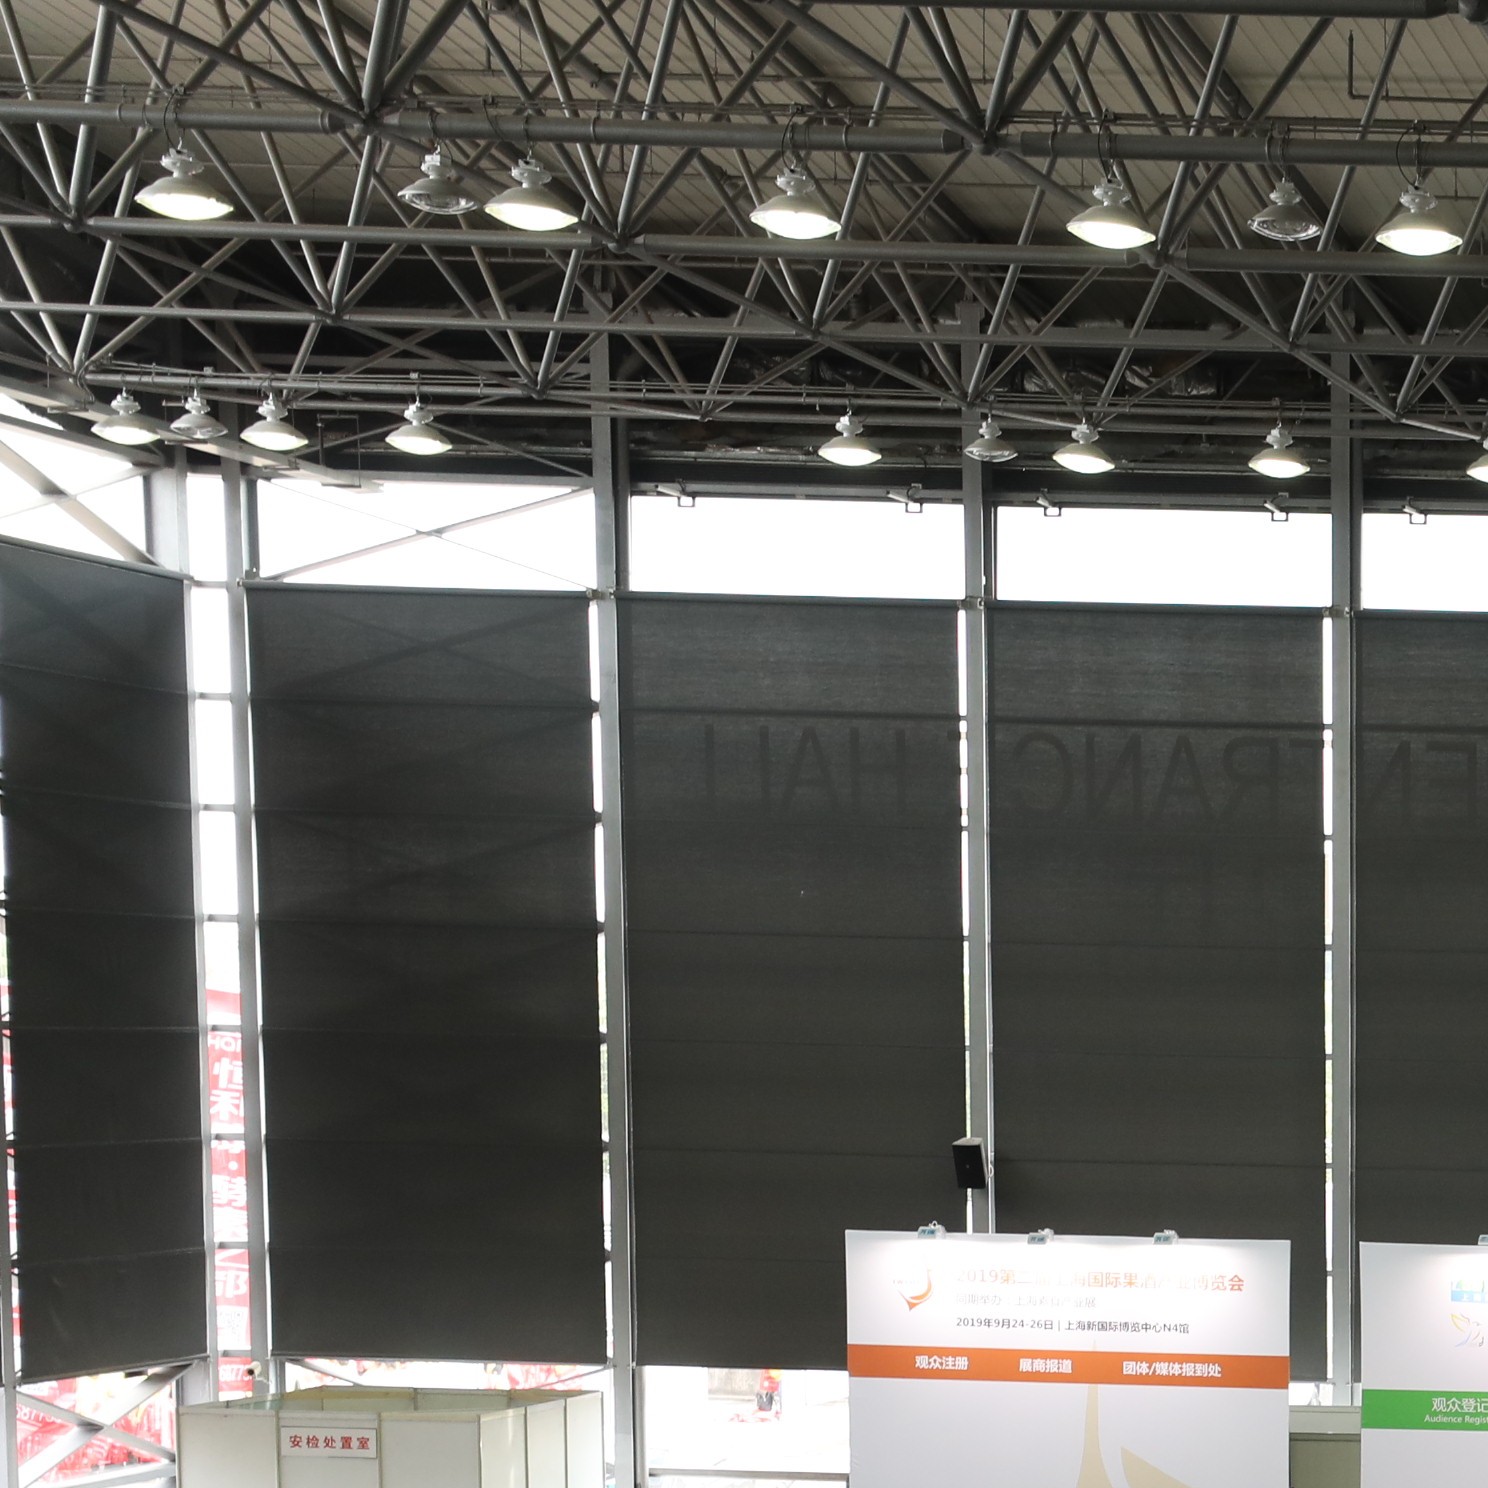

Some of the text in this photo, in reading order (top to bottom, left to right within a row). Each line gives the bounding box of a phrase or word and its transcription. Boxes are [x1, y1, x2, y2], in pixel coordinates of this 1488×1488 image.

[956, 1317, 1190, 1335] 2019年9月24-26日 上海新国际博览中心N4馆
[915, 1355, 969, 1371] 观众注册
[1019, 1358, 1072, 1374] 展商报道
[1122, 1361, 1222, 1378] 团体/媒体报到处
[1424, 1414, 1463, 1424] Audience
[289, 1434, 370, 1450] 安检处置室
